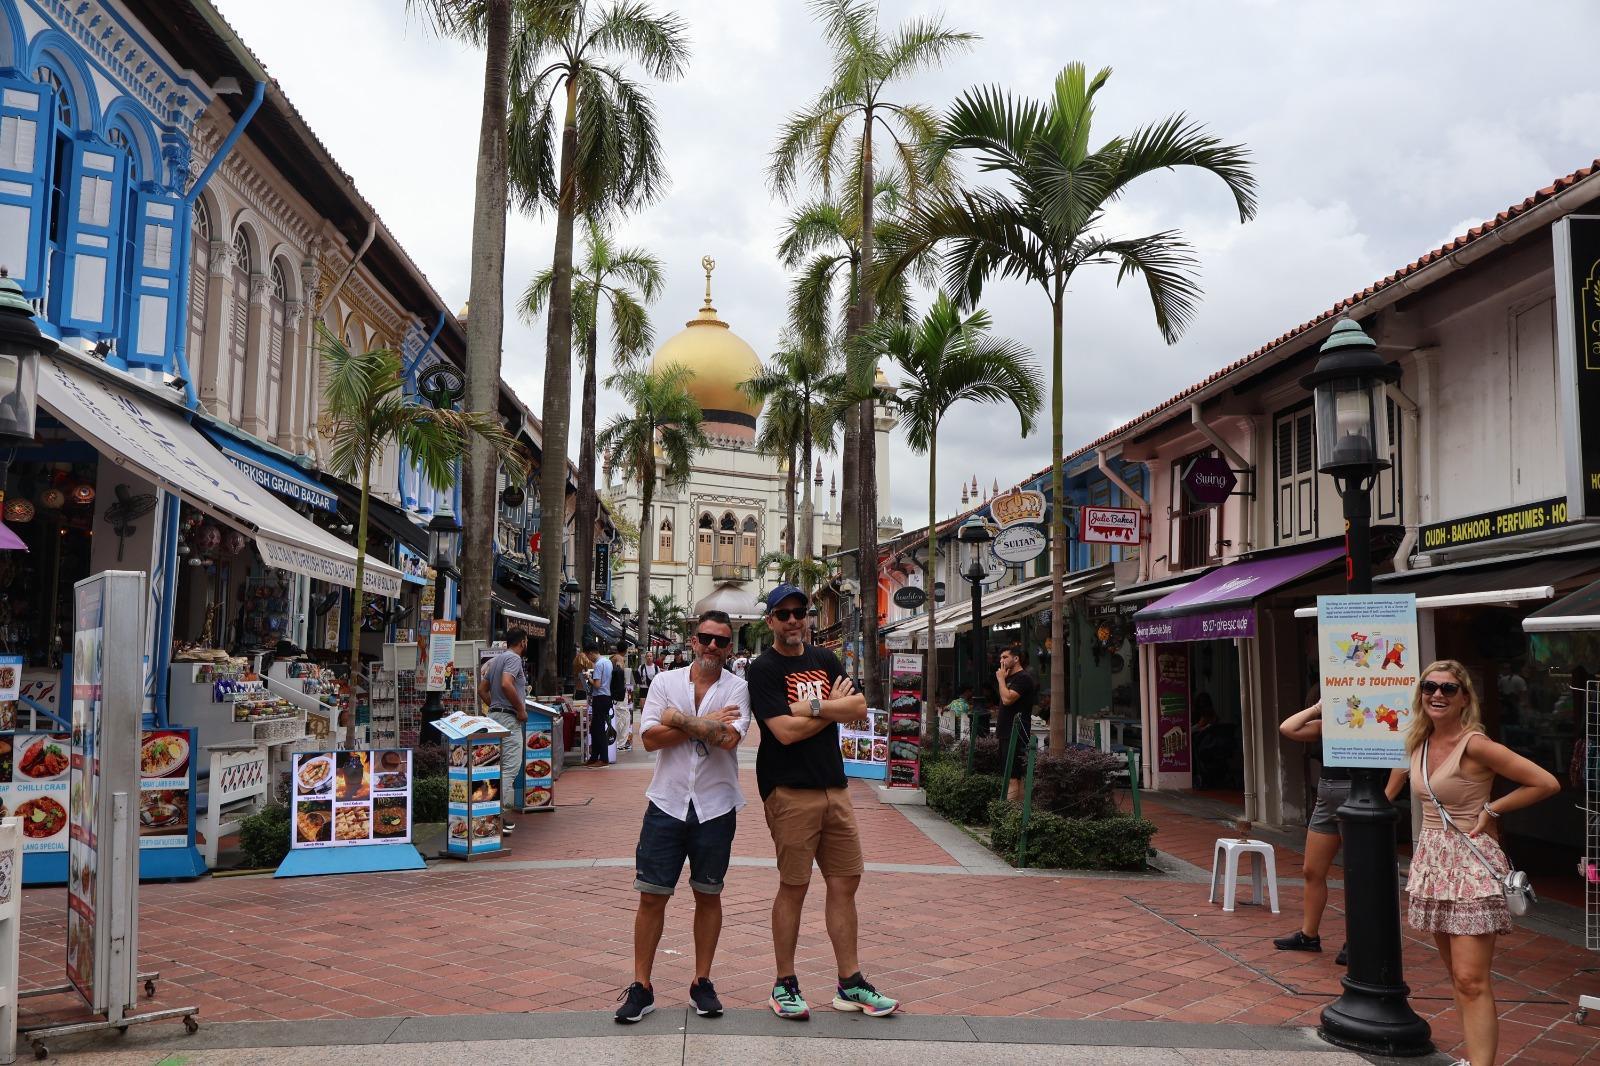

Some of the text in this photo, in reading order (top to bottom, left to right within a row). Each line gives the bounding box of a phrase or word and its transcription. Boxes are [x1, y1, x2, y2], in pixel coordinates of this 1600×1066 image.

[230, 458, 330, 510] TURKISH GRAND BAZAAR
[1195, 472, 1226, 488] Swing
[1425, 527, 1446, 547] OUDH
[1451, 518, 1491, 543] BAKHOOR
[1497, 507, 1544, 534] PERFUMES
[1551, 502, 1568, 525] HO
[1003, 537, 1036, 548] SULTAN
[1325, 676, 1416, 687] WHAT IS TOUTING?
[796, 680, 823, 701] CAT
[17, 783, 67, 792] CHILLI CRAB
[40, 842, 65, 851] SPECIAL
